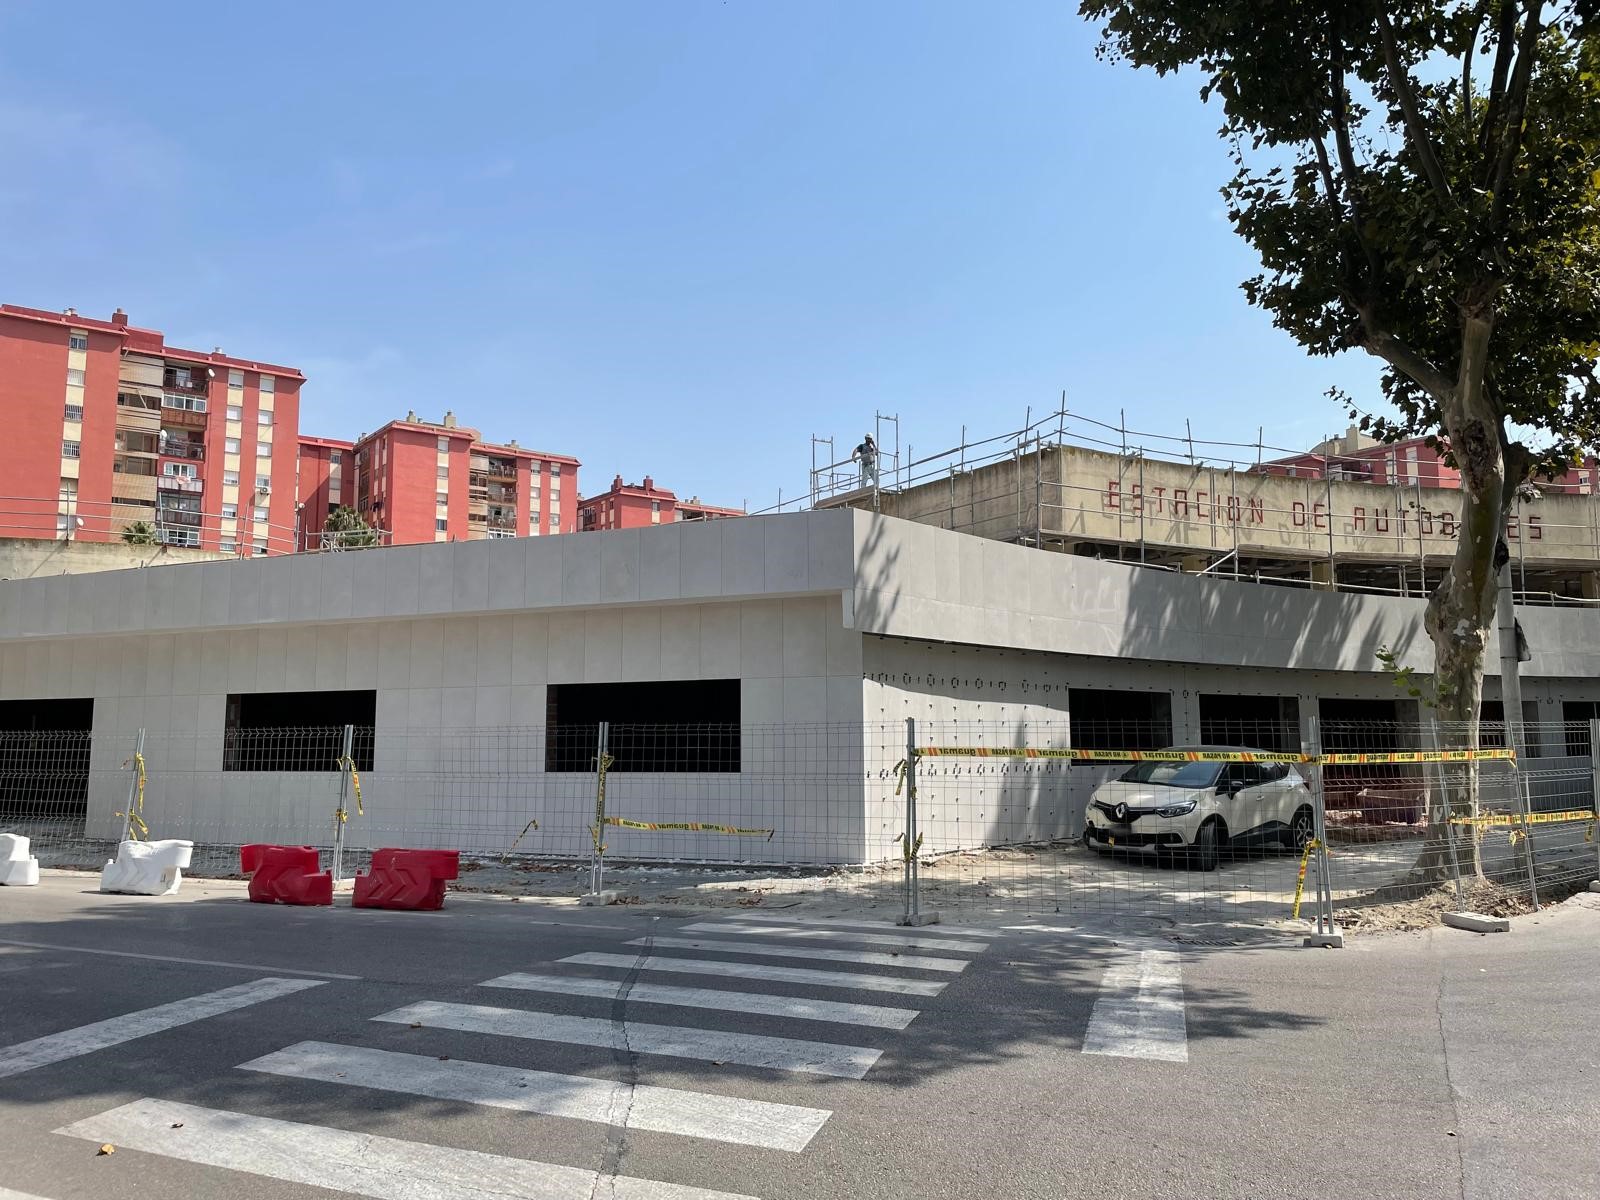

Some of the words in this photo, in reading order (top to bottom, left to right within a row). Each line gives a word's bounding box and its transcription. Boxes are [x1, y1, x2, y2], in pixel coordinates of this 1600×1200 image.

[1109, 481, 1263, 524] ESTACION
[1292, 502, 1326, 528] DE
[1353, 506, 1541, 540] AUTOBES
